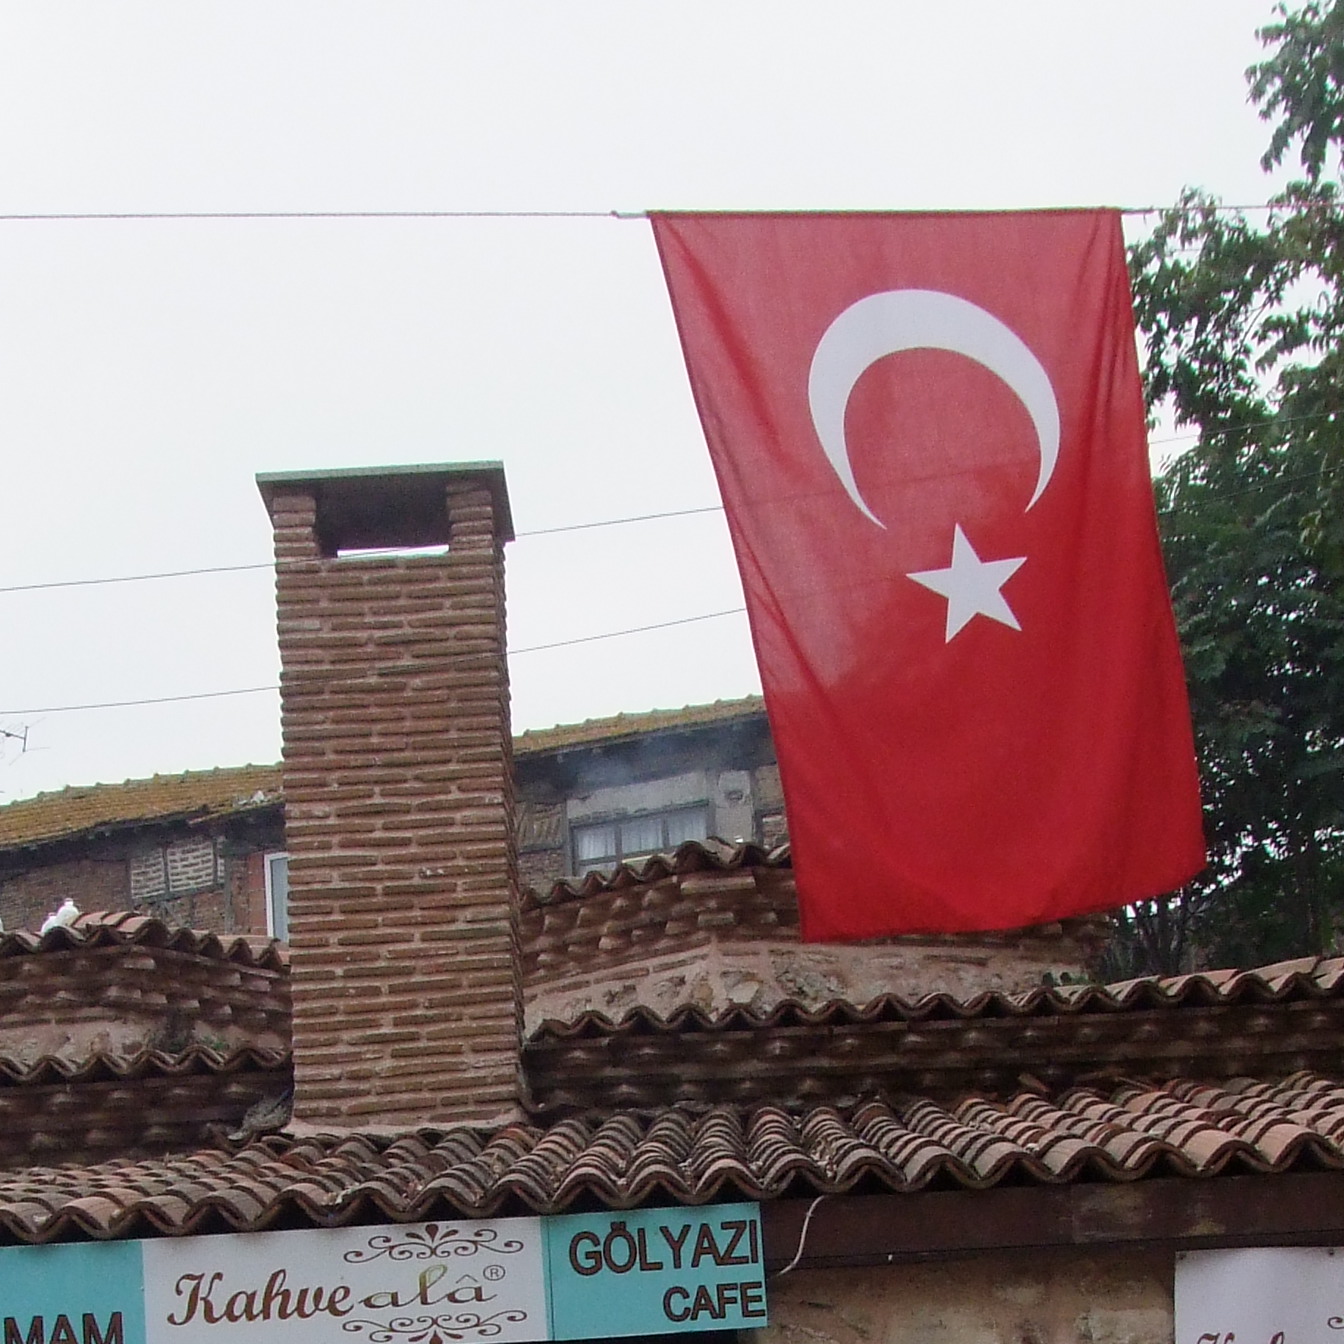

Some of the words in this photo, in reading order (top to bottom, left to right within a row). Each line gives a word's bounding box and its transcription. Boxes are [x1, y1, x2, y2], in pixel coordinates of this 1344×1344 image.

[568, 1219, 759, 1276] GÖLYAZI
[167, 1269, 354, 1326] Kahve
[663, 1281, 766, 1322] CAFE
